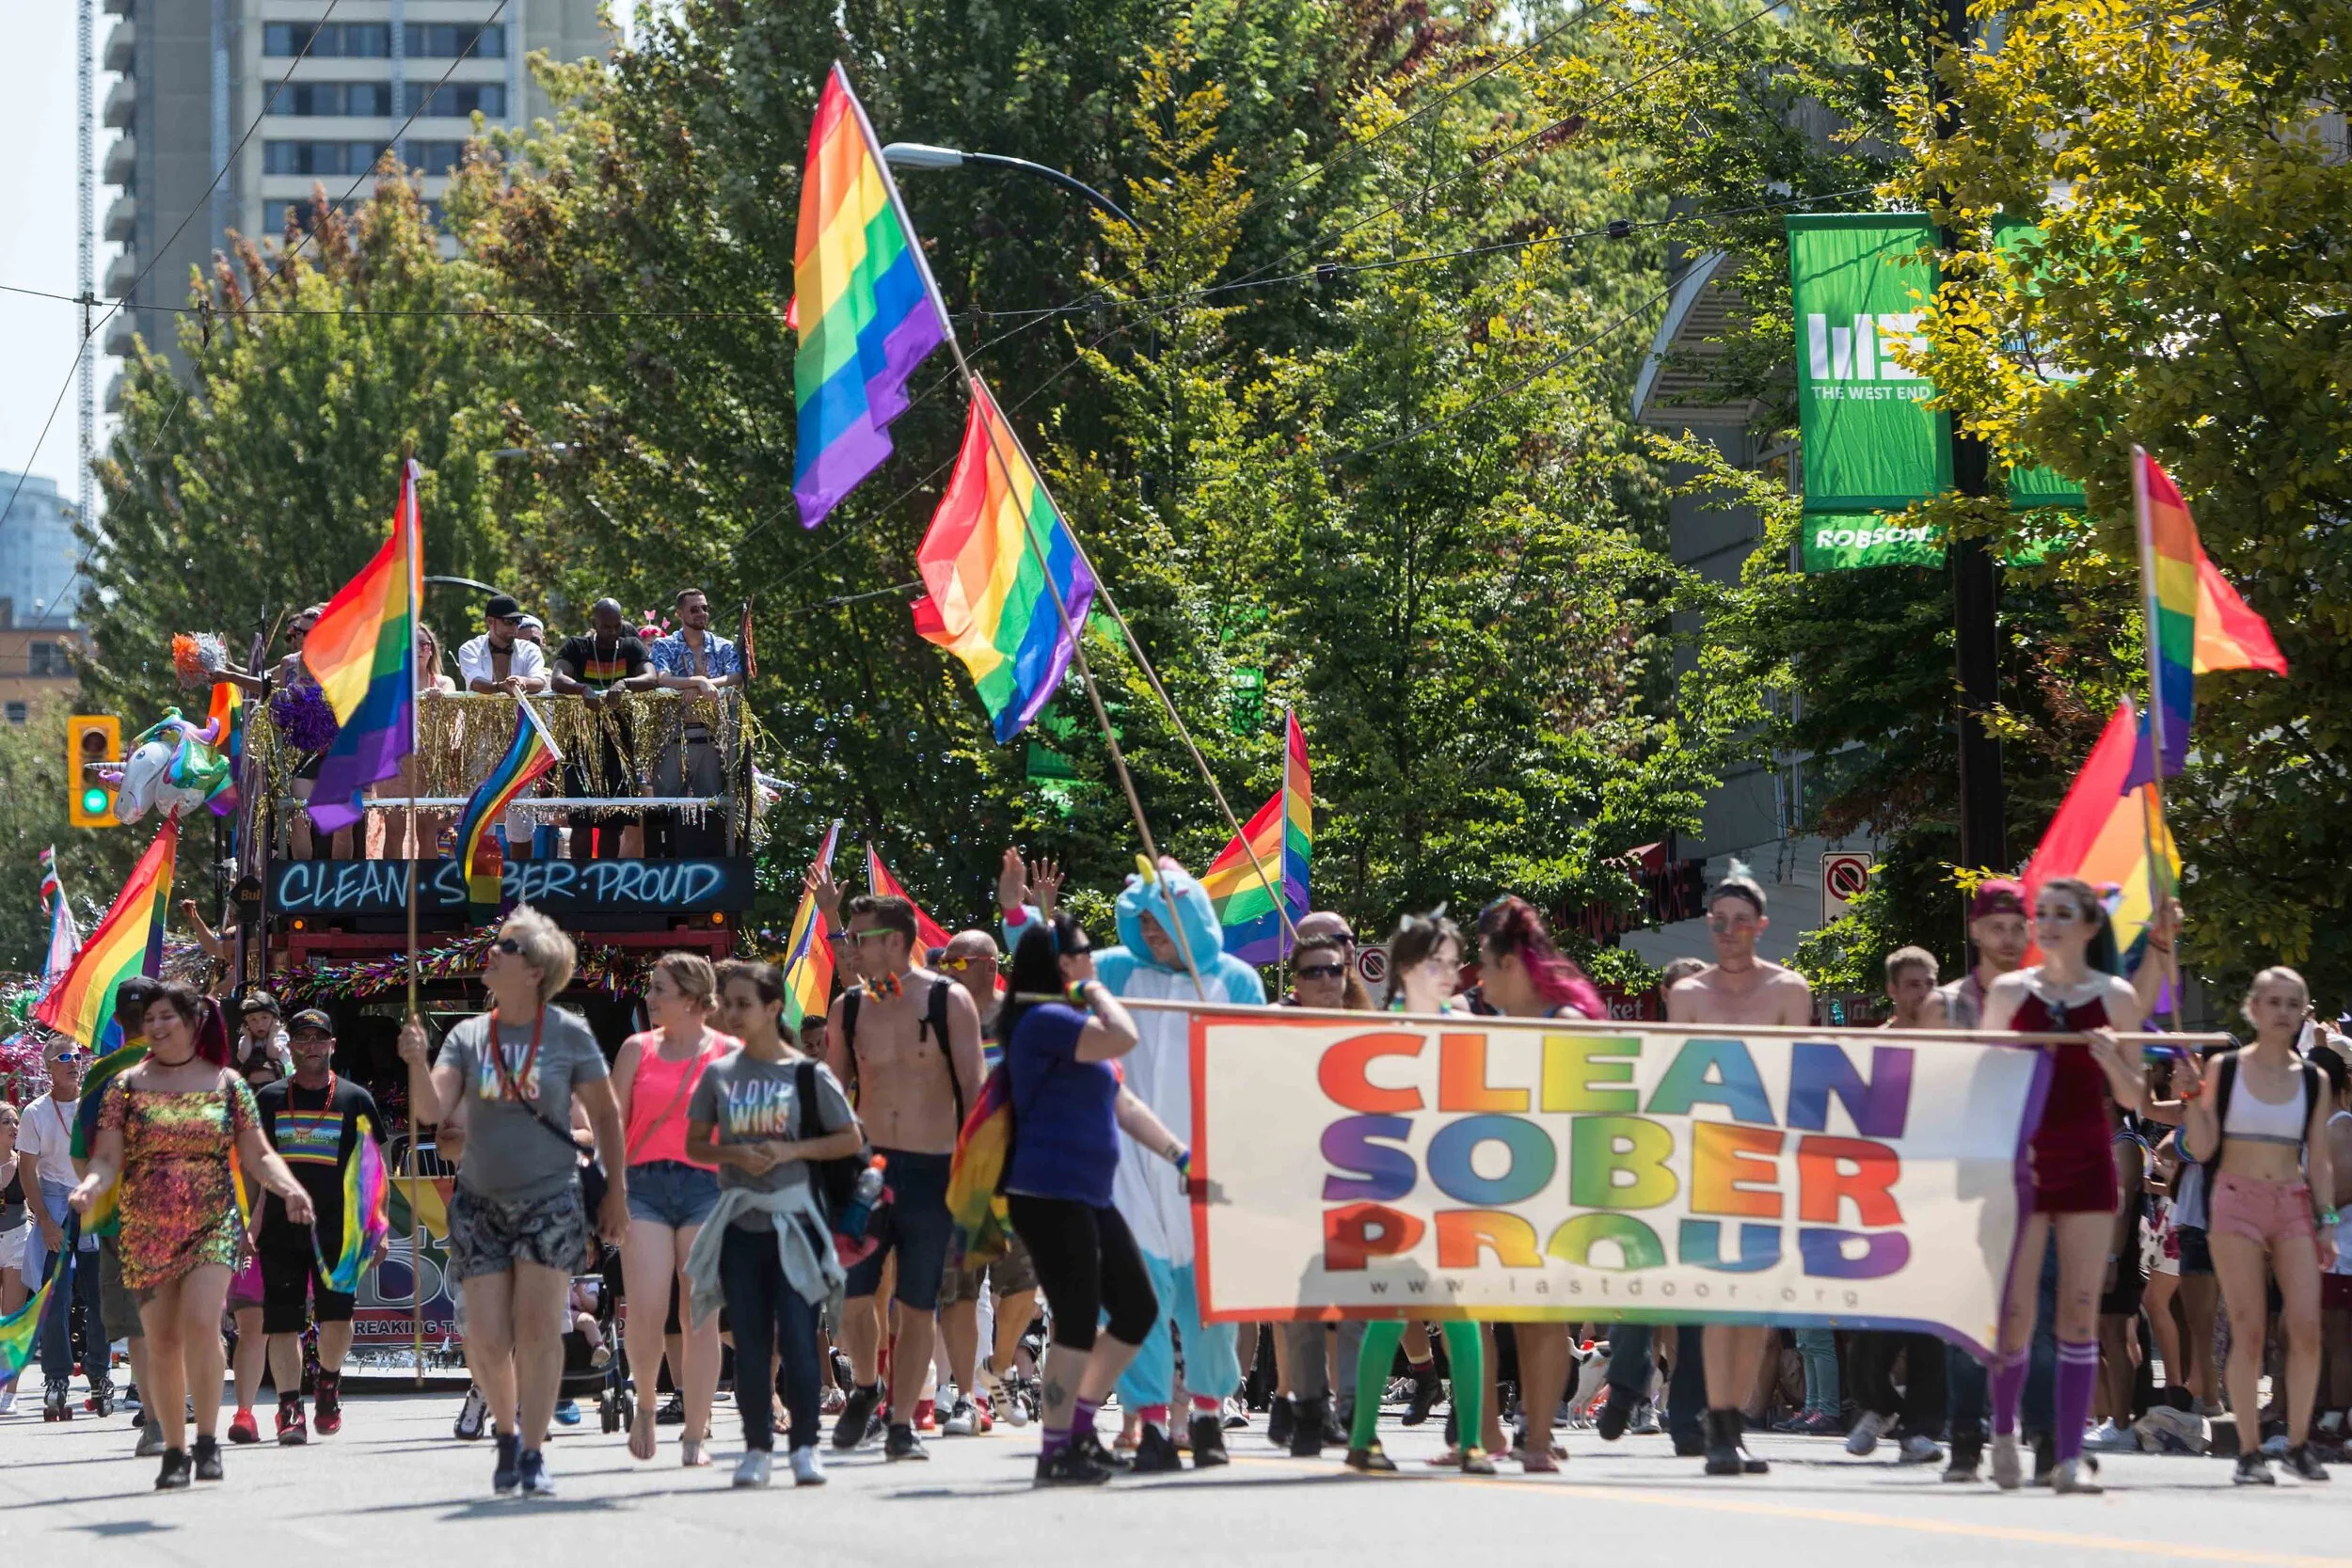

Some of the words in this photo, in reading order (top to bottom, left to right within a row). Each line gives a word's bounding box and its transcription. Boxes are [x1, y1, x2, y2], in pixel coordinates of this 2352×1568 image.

[1811, 387, 1845, 400] THE
[1849, 387, 1893, 400] WEST
[1897, 387, 1931, 400] END
[279, 860, 410, 910] CLEAN
[435, 861, 576, 904] SBER
[581, 862, 721, 905] PROUD
[1606, 996, 1645, 1021] ket
[1317, 1031, 1915, 1140] CLEAN
[728, 1102, 789, 1134] WINS
[1319, 1112, 1906, 1228] SOBER
[1322, 1201, 1912, 1281] PROUD
[354, 1320, 437, 1336] REAKIG
